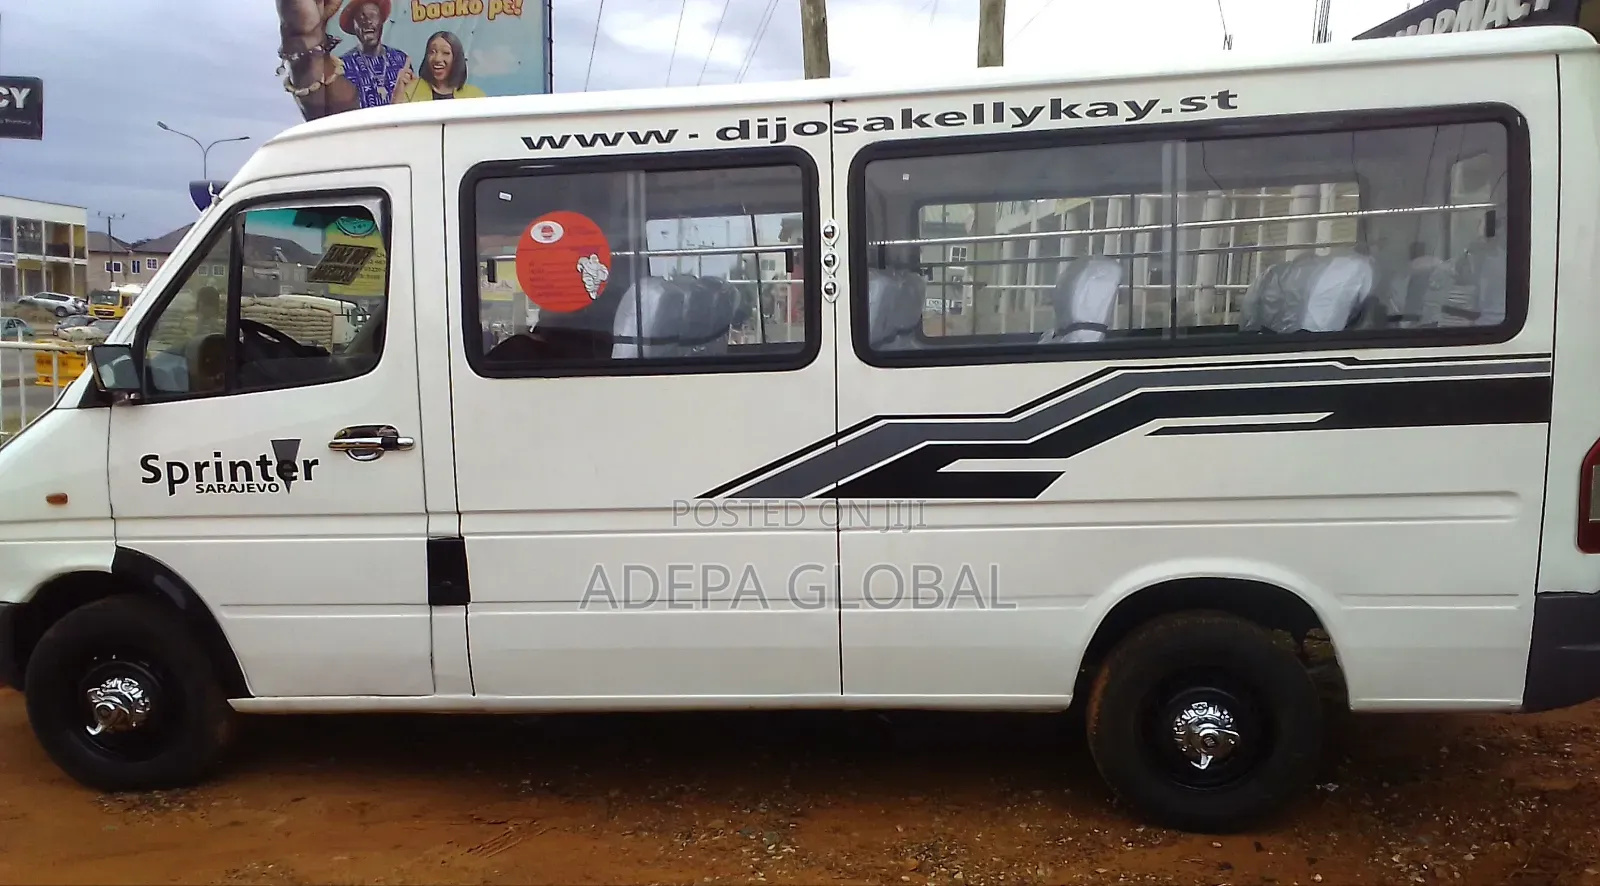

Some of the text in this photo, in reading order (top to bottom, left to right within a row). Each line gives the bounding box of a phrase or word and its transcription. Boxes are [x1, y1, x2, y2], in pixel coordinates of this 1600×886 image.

[411, 0, 484, 22] baako
[139, 451, 320, 497] Sprinter
[195, 482, 280, 495] SARAJEVO
